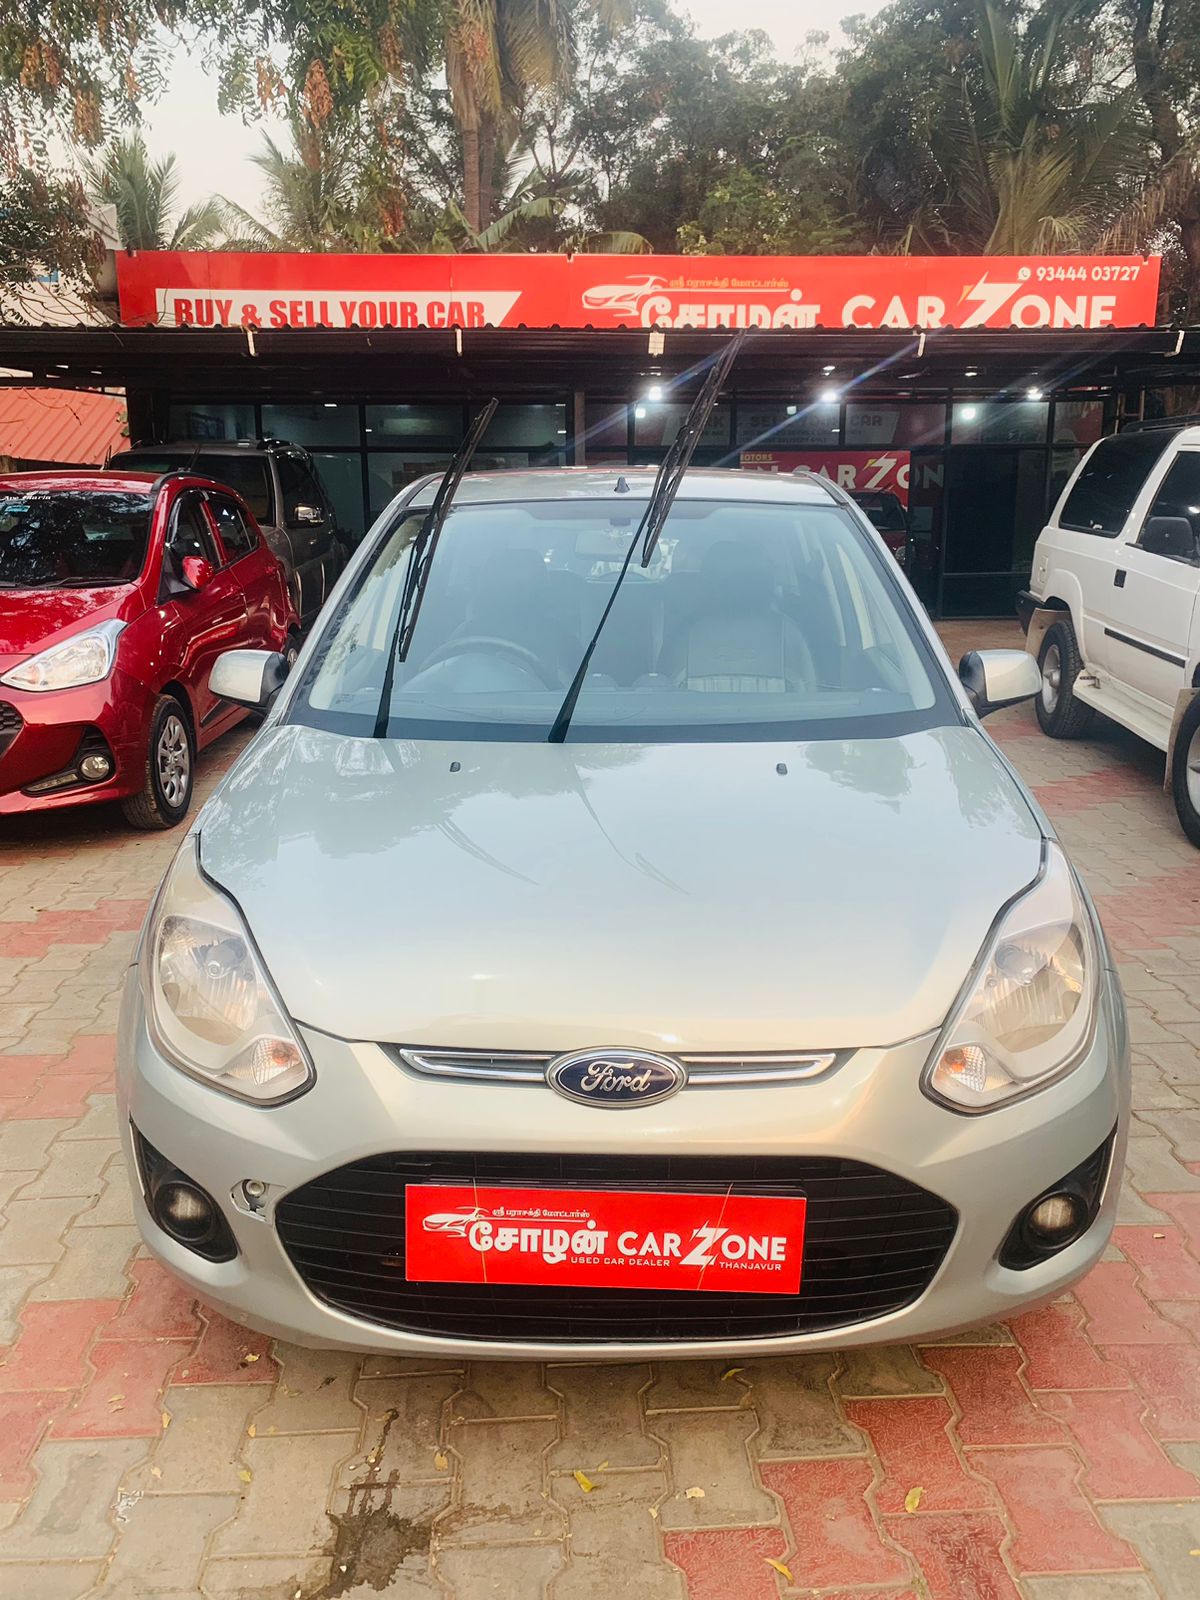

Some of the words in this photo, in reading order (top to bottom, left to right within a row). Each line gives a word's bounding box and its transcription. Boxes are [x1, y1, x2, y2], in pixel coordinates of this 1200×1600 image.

[1035, 266, 1088, 281] 93444
[1091, 265, 1141, 281] 03727
[174, 298, 233, 326] BUY
[240, 303, 262, 327] &
[269, 299, 333, 328] SELL
[340, 300, 418, 328] YOUR
[426, 300, 485, 328] CAR
[841, 294, 946, 328] CAR
[580, 1060, 652, 1092] Ford
[506, 1207, 541, 1218] பராசக்தி
[542, 1208, 590, 1218] மோட்டார்ஸ்
[468, 1219, 609, 1264] சோழன்
[617, 1231, 682, 1258] CAR
[679, 1220, 787, 1272] ZONE
[570, 1256, 600, 1264] USED
[603, 1257, 625, 1266] CAR
[628, 1258, 670, 1267] DEALER
[719, 1261, 782, 1271] THANJAVUR
